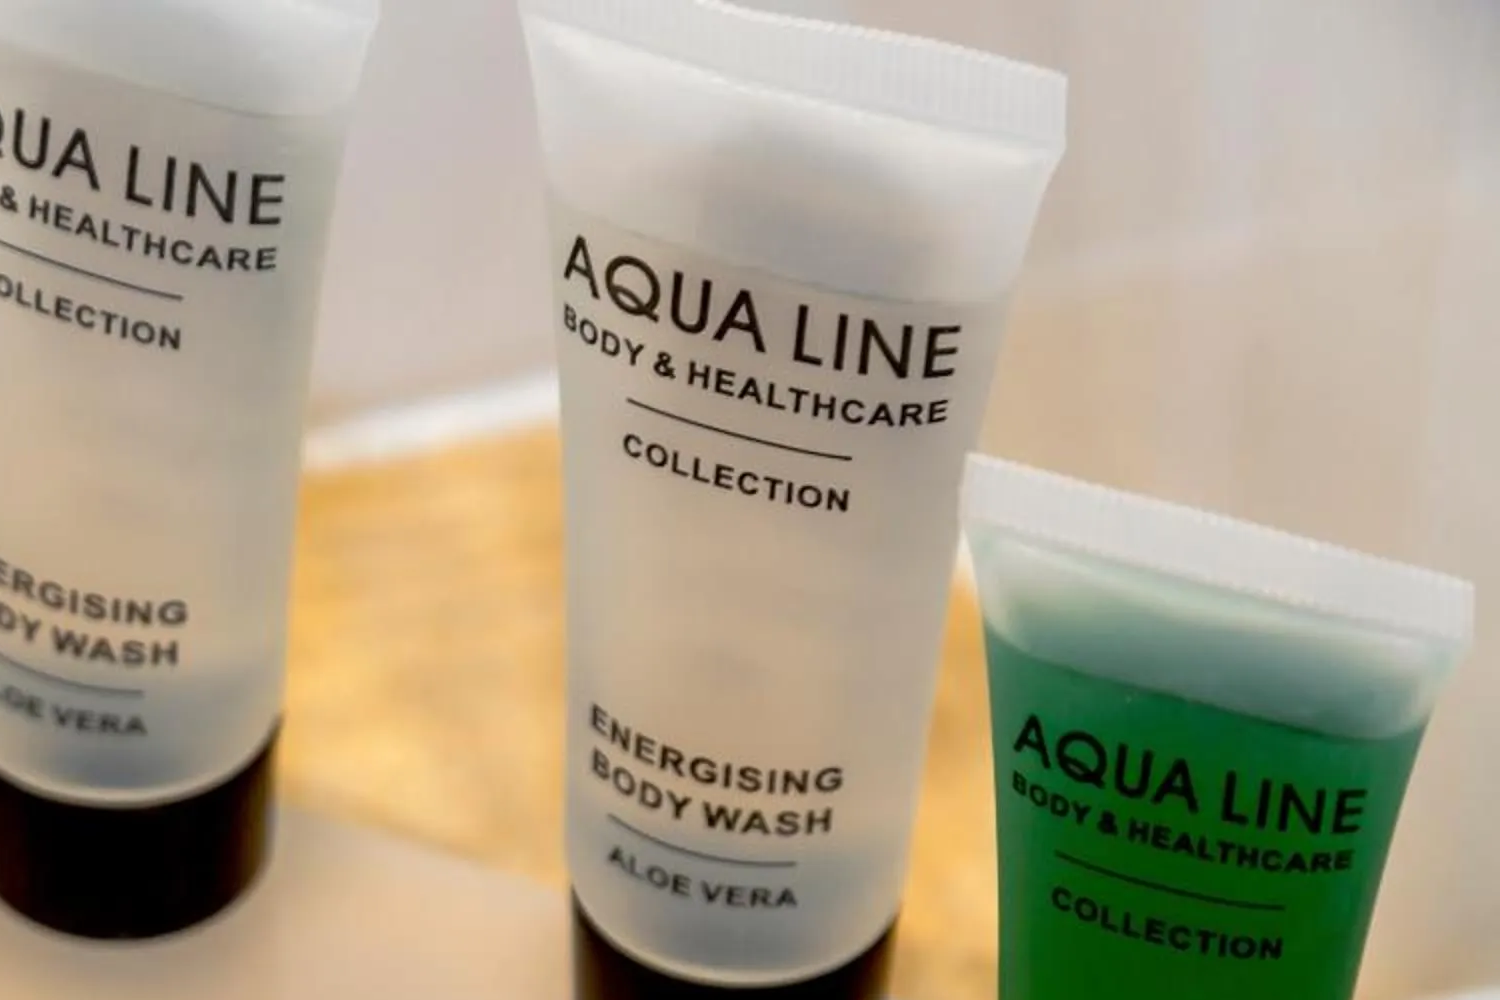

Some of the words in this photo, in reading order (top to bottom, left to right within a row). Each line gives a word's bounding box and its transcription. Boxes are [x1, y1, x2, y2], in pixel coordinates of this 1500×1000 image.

[124, 145, 285, 226] LINE
[28, 195, 278, 271] HEALTHCARE
[564, 235, 767, 353] AQUA
[793, 304, 961, 380] LINE
[564, 303, 645, 366] BODY
[653, 351, 677, 379] &
[687, 362, 948, 427] HEALTHCARE
[623, 433, 850, 513] COLLECTION
[51, 624, 179, 667] WASH
[51, 701, 147, 737] VERA
[590, 704, 843, 794] ENERGISING
[591, 748, 693, 820] BODY
[703, 801, 833, 837] WASH
[1013, 714, 1199, 815] AQUA
[1221, 769, 1367, 835] LINE
[1012, 770, 1092, 827] BODY
[1097, 812, 1117, 836] &
[1128, 820, 1354, 872] HEALTHCARE
[607, 844, 691, 898] ALOE
[701, 879, 798, 909] VERA
[1051, 885, 1283, 960] COLLECTION
